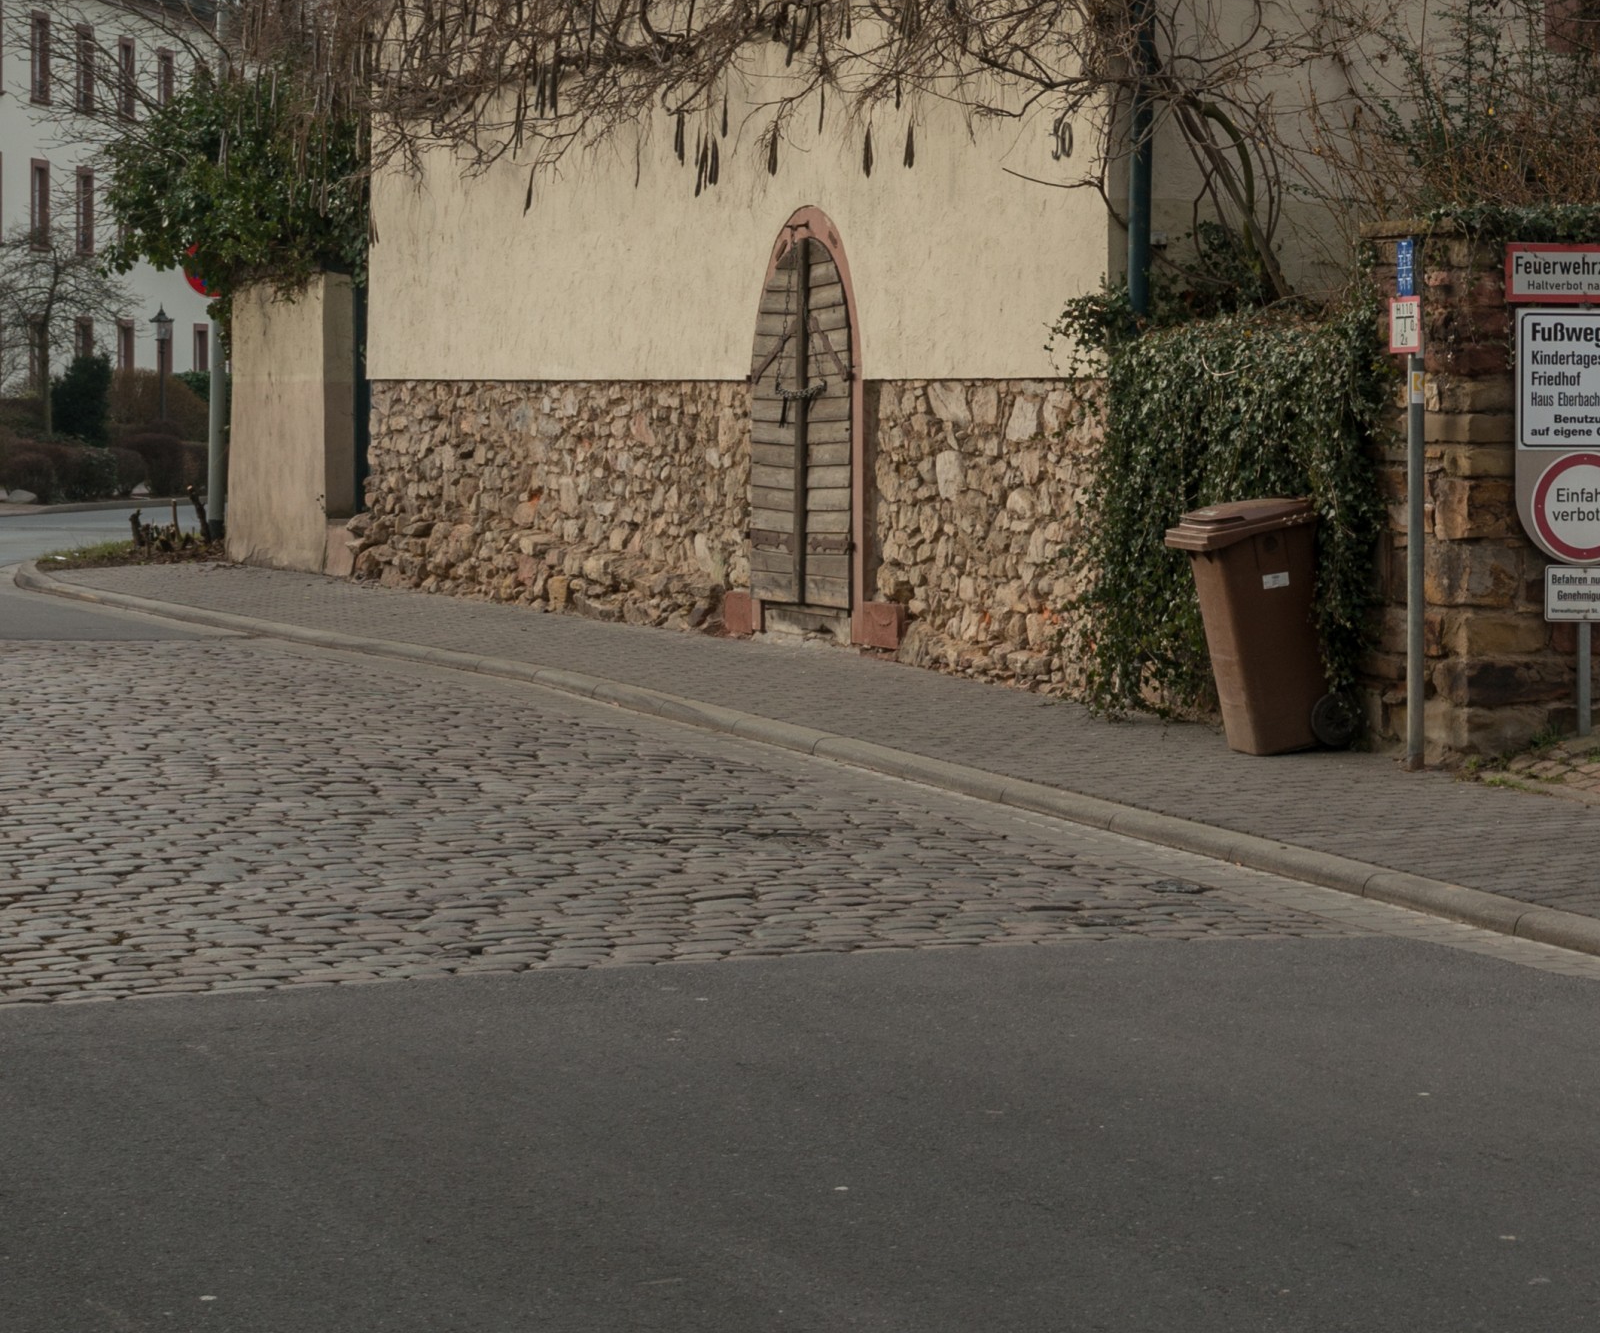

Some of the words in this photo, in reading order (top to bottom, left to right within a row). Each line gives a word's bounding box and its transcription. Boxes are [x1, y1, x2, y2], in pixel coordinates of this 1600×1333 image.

[1527, 280, 1583, 291] Haltverbot
[1531, 371, 1581, 386] Friedhof
[1531, 392, 1554, 407] Haus
[1531, 427, 1550, 437] auf
[1553, 427, 1592, 438] eigene
[1551, 574, 1588, 585] Befahren
